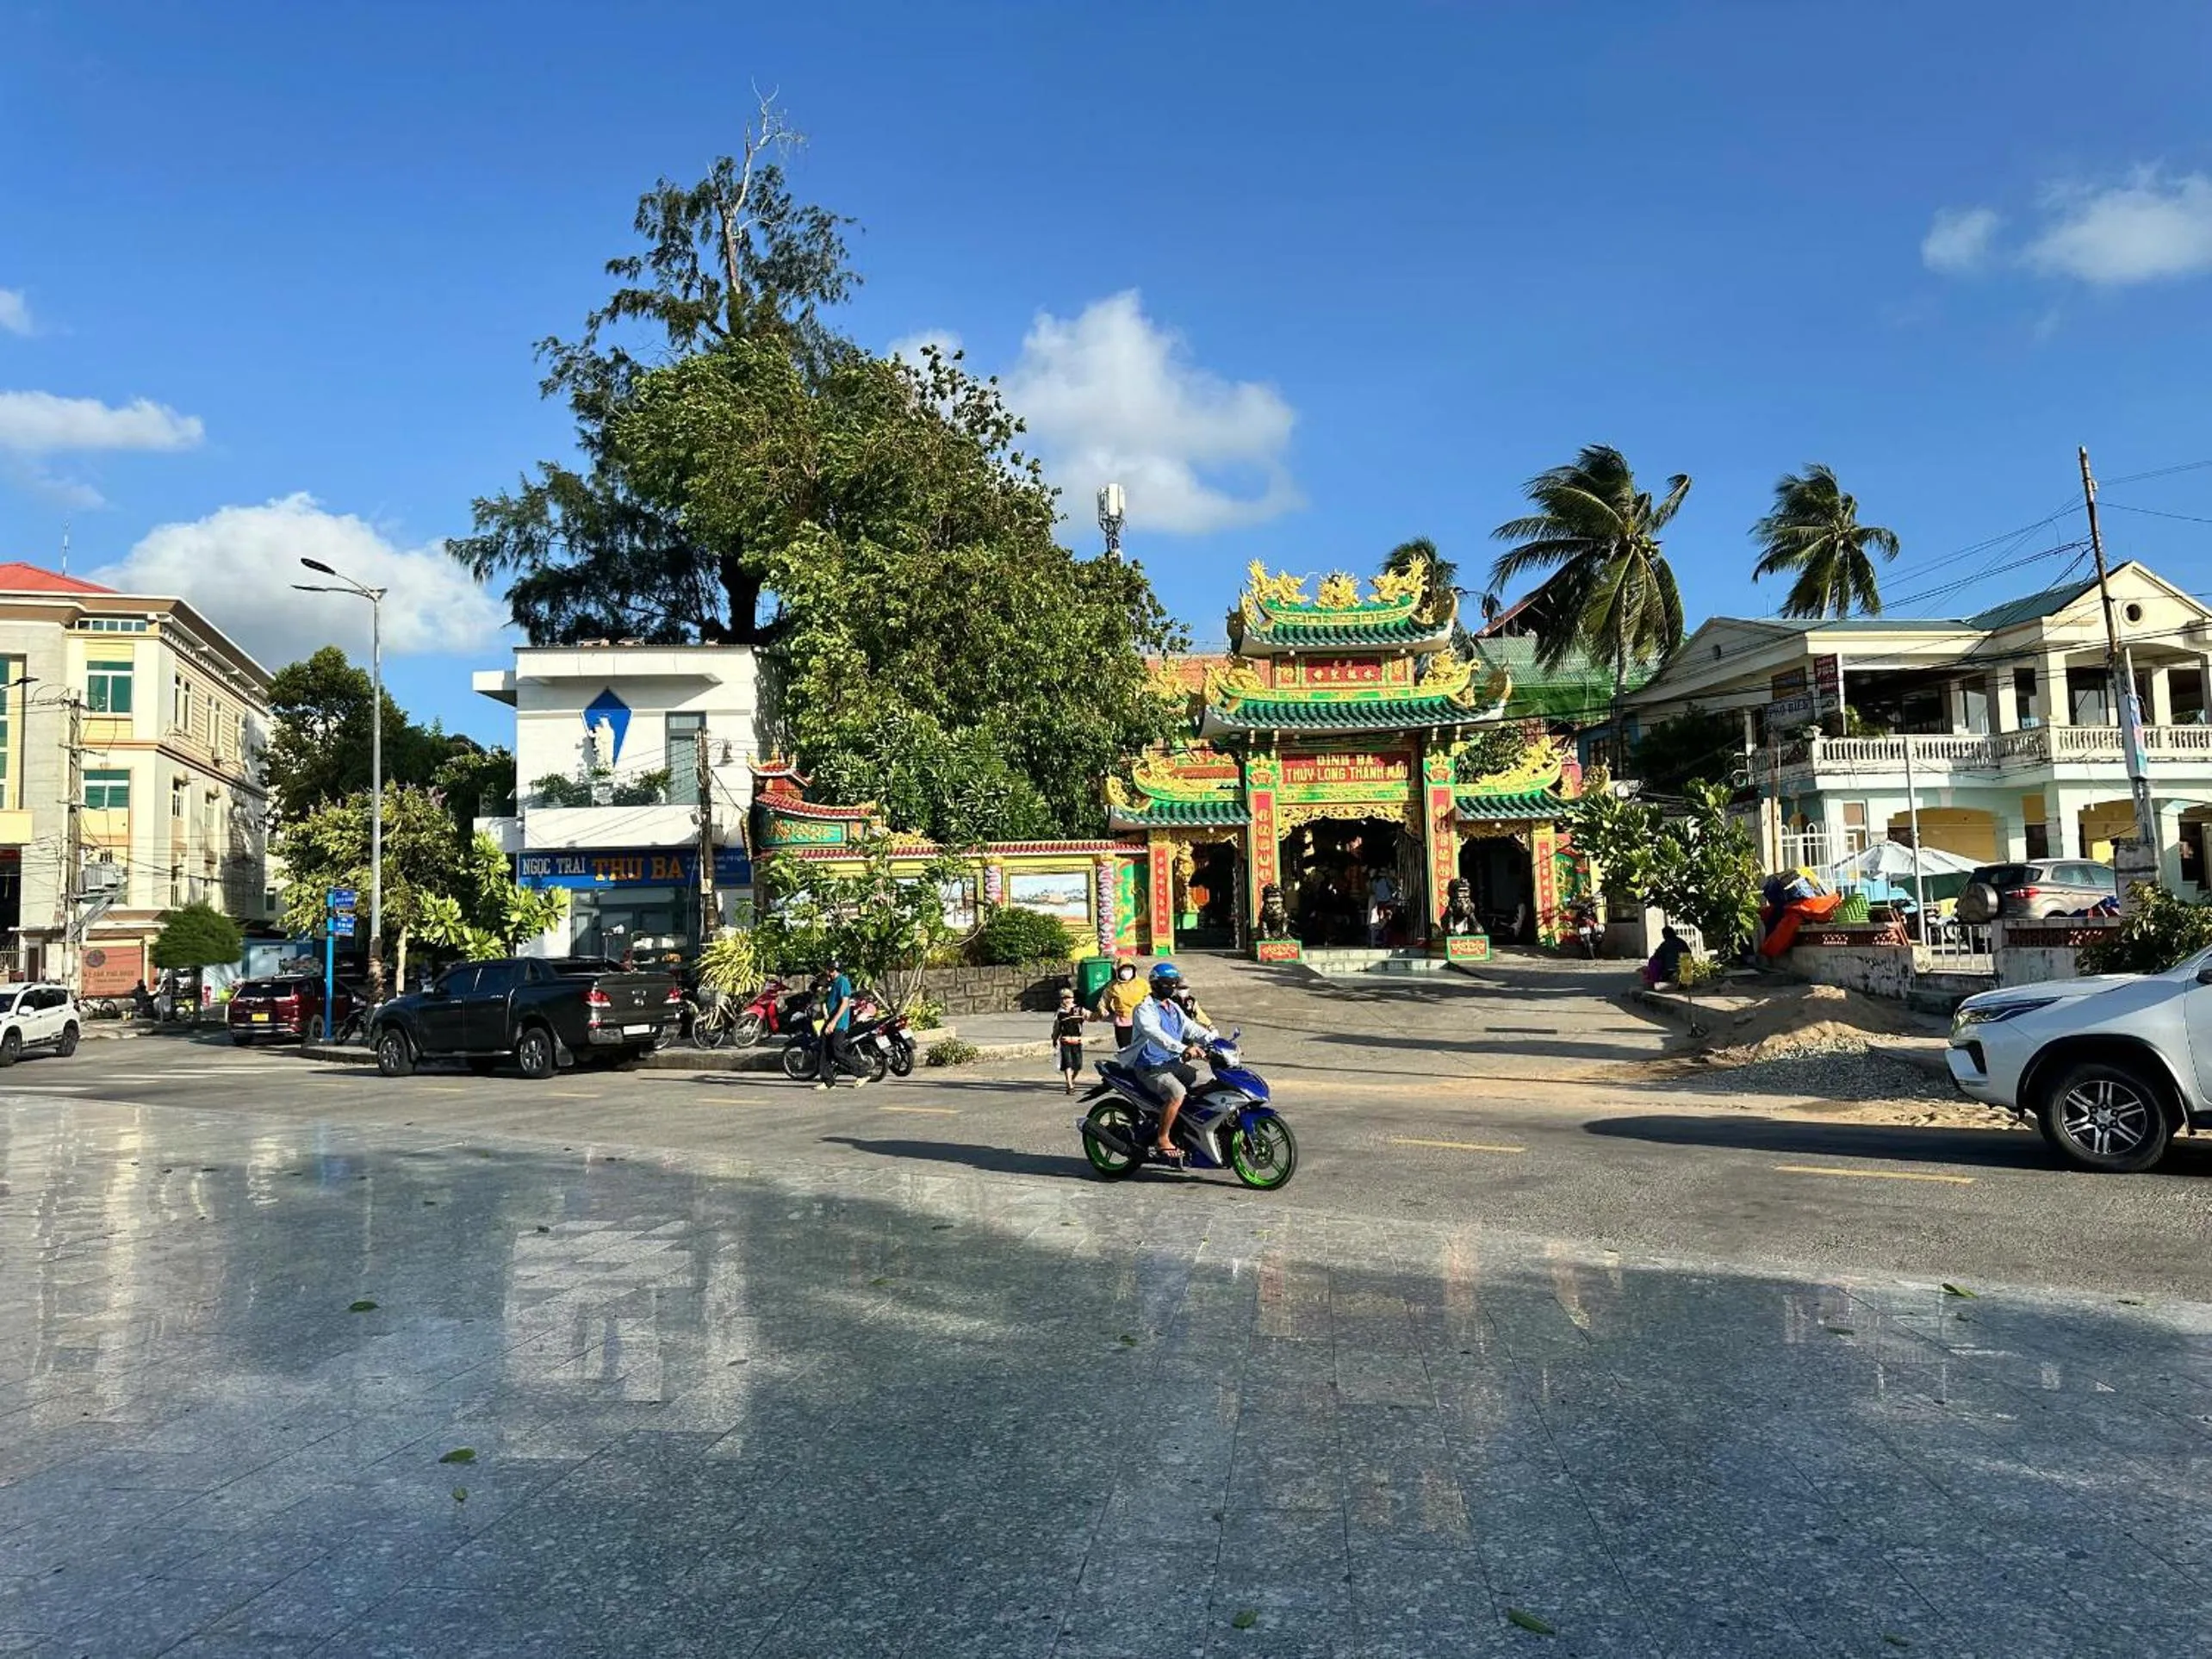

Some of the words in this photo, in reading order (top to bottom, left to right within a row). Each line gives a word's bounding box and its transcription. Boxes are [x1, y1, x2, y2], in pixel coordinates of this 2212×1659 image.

[1317, 767, 1346, 781] LONG
[522, 858, 551, 878] NGỌC
[556, 856, 586, 873] TRAI
[592, 857, 643, 880] THU
[650, 856, 686, 879] BA
